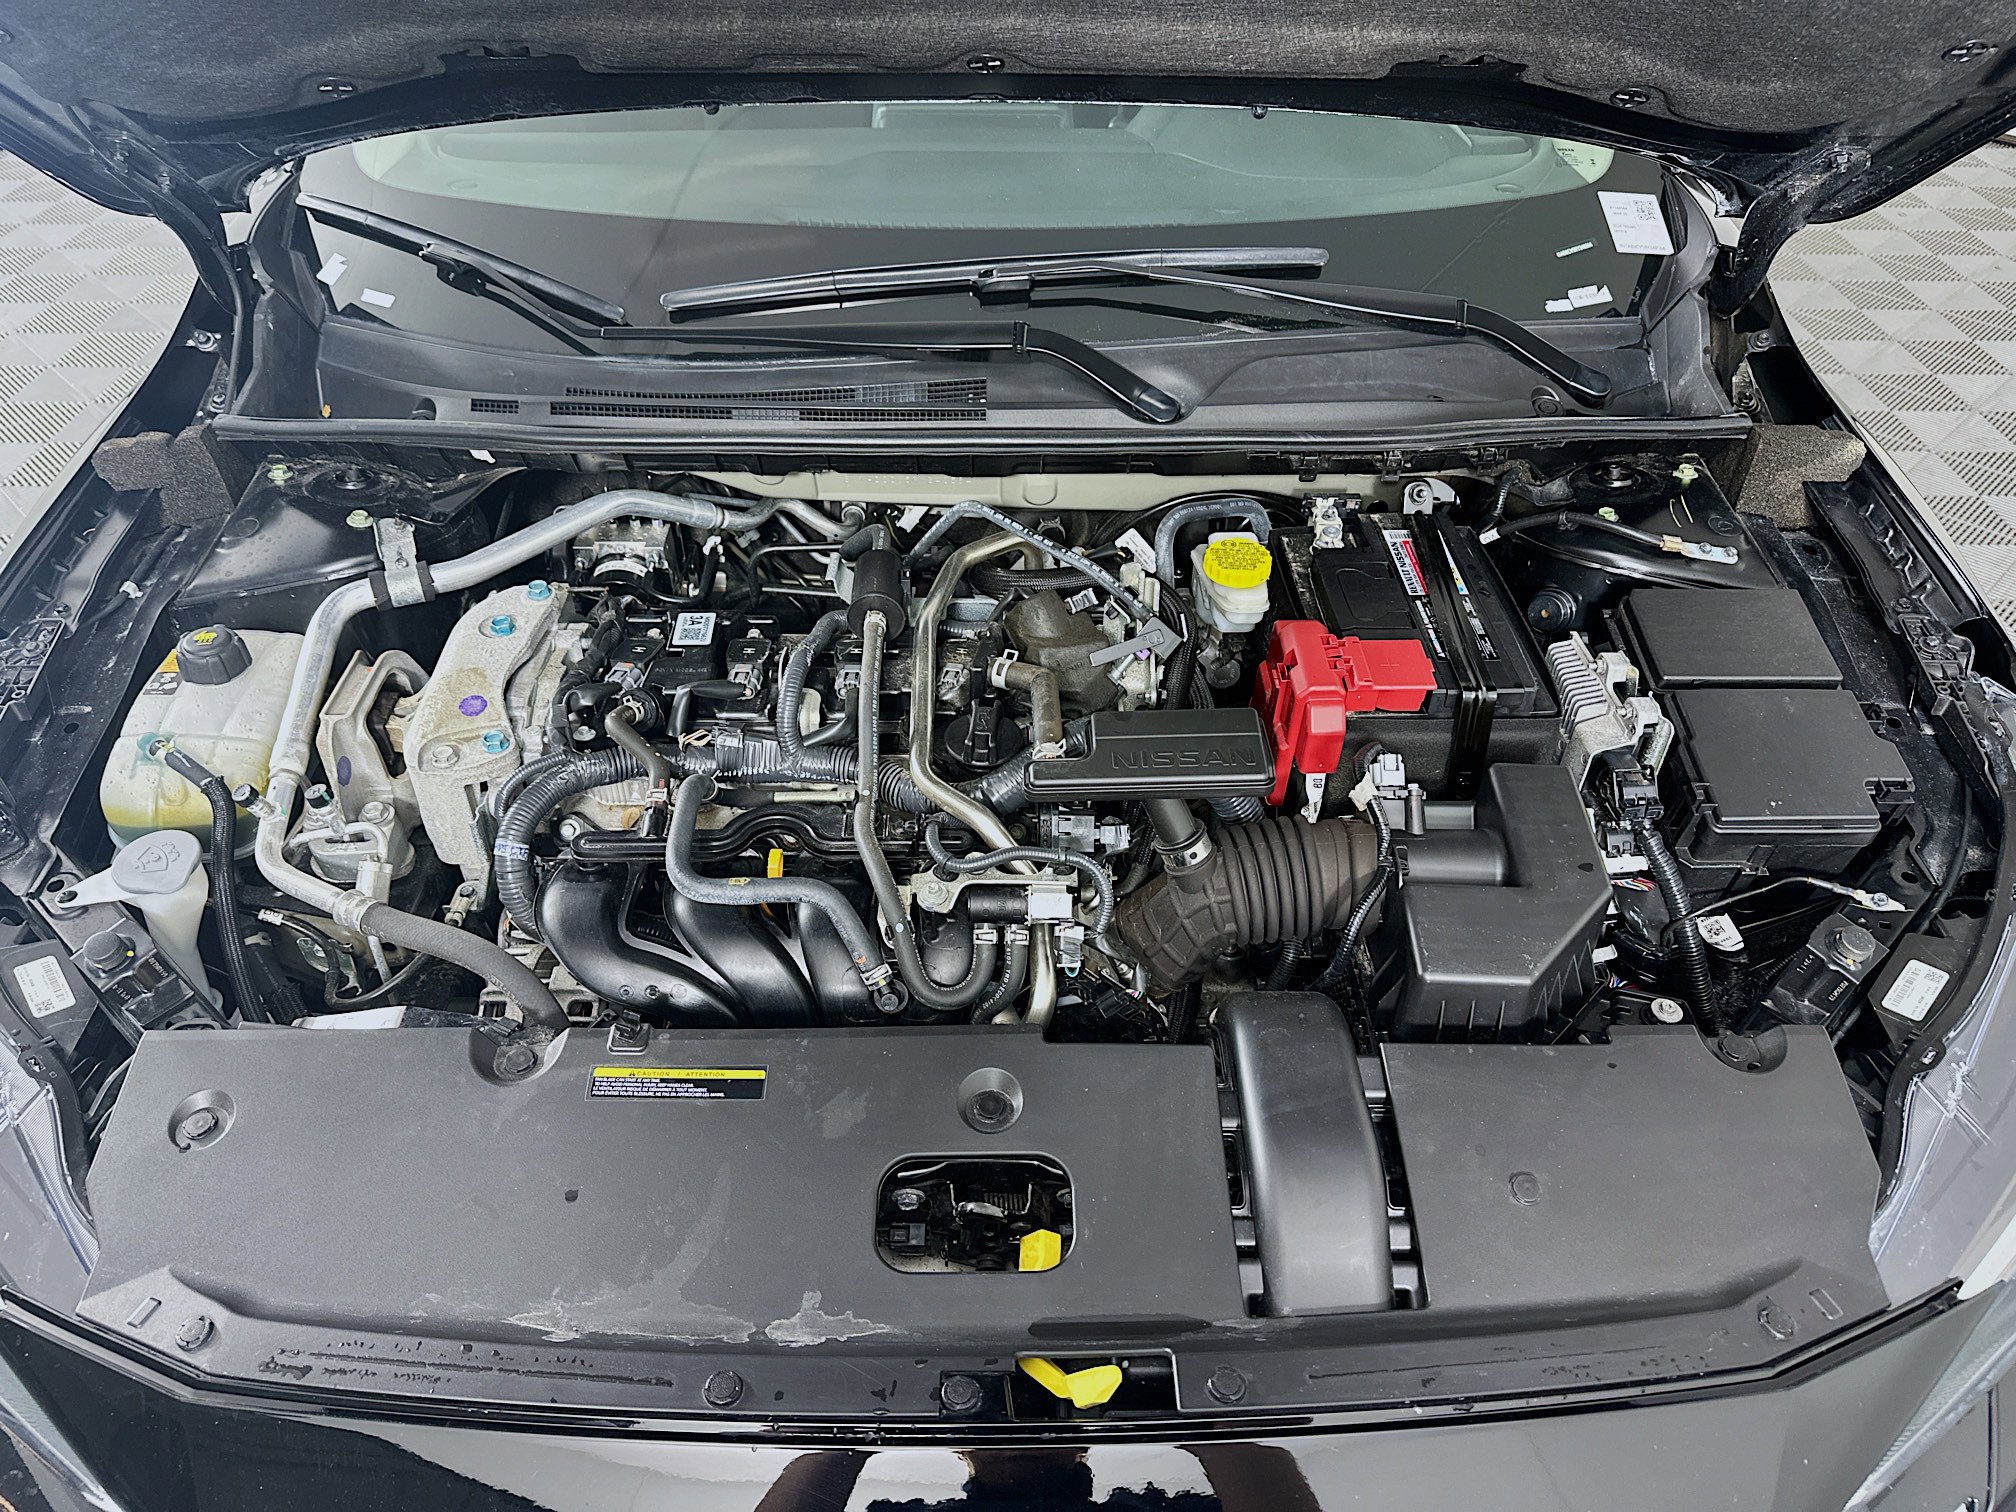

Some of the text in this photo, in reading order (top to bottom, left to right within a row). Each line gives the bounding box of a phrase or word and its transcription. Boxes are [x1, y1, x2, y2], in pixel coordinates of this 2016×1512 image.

[1390, 540, 1407, 569] NISSAN
[687, 614, 704, 627] 3A
[1111, 749, 1256, 769] NISSAN
